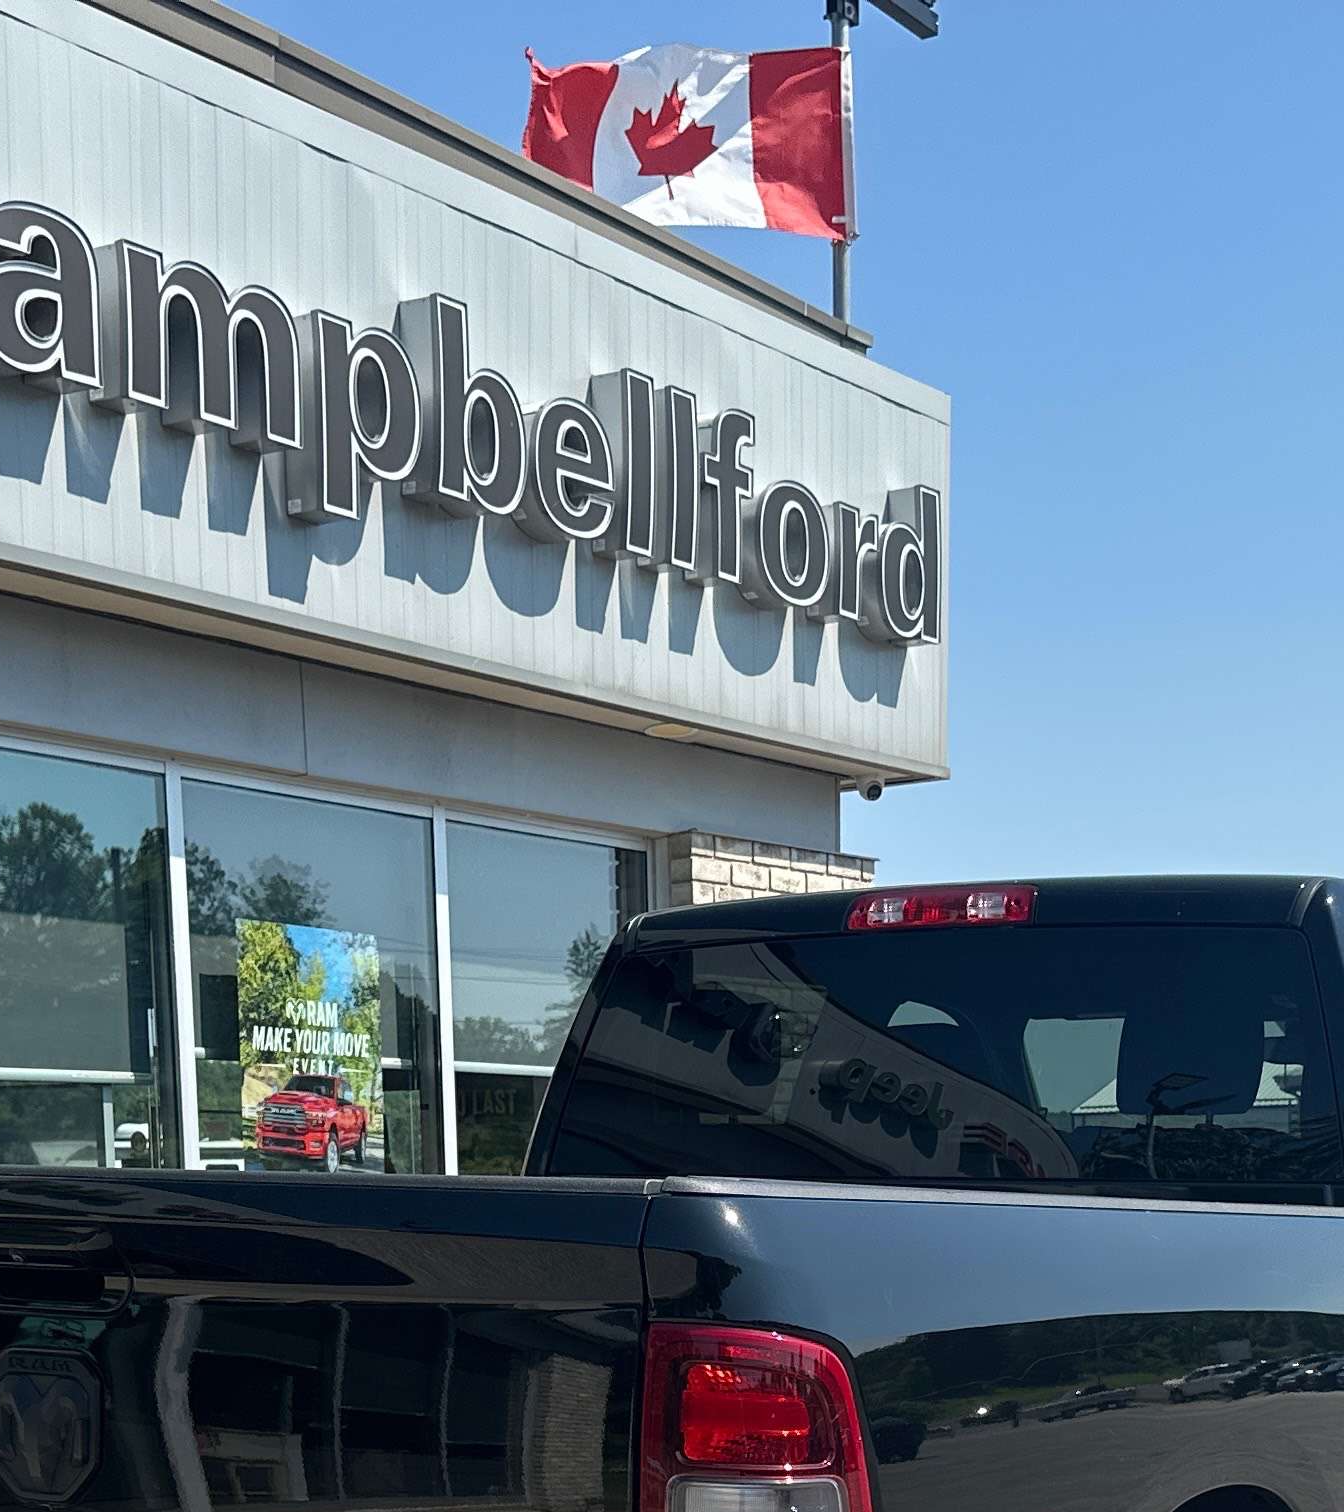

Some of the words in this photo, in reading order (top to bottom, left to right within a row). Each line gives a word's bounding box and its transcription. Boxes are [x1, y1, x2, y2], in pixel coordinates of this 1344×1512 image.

[307, 1000, 339, 1028] RAM
[252, 1025, 293, 1053] MAKE
[295, 1028, 331, 1055] YOUR
[333, 1031, 371, 1058] MOVE
[293, 1057, 335, 1076] EVENT
[8, 1355, 73, 1373] RAM
